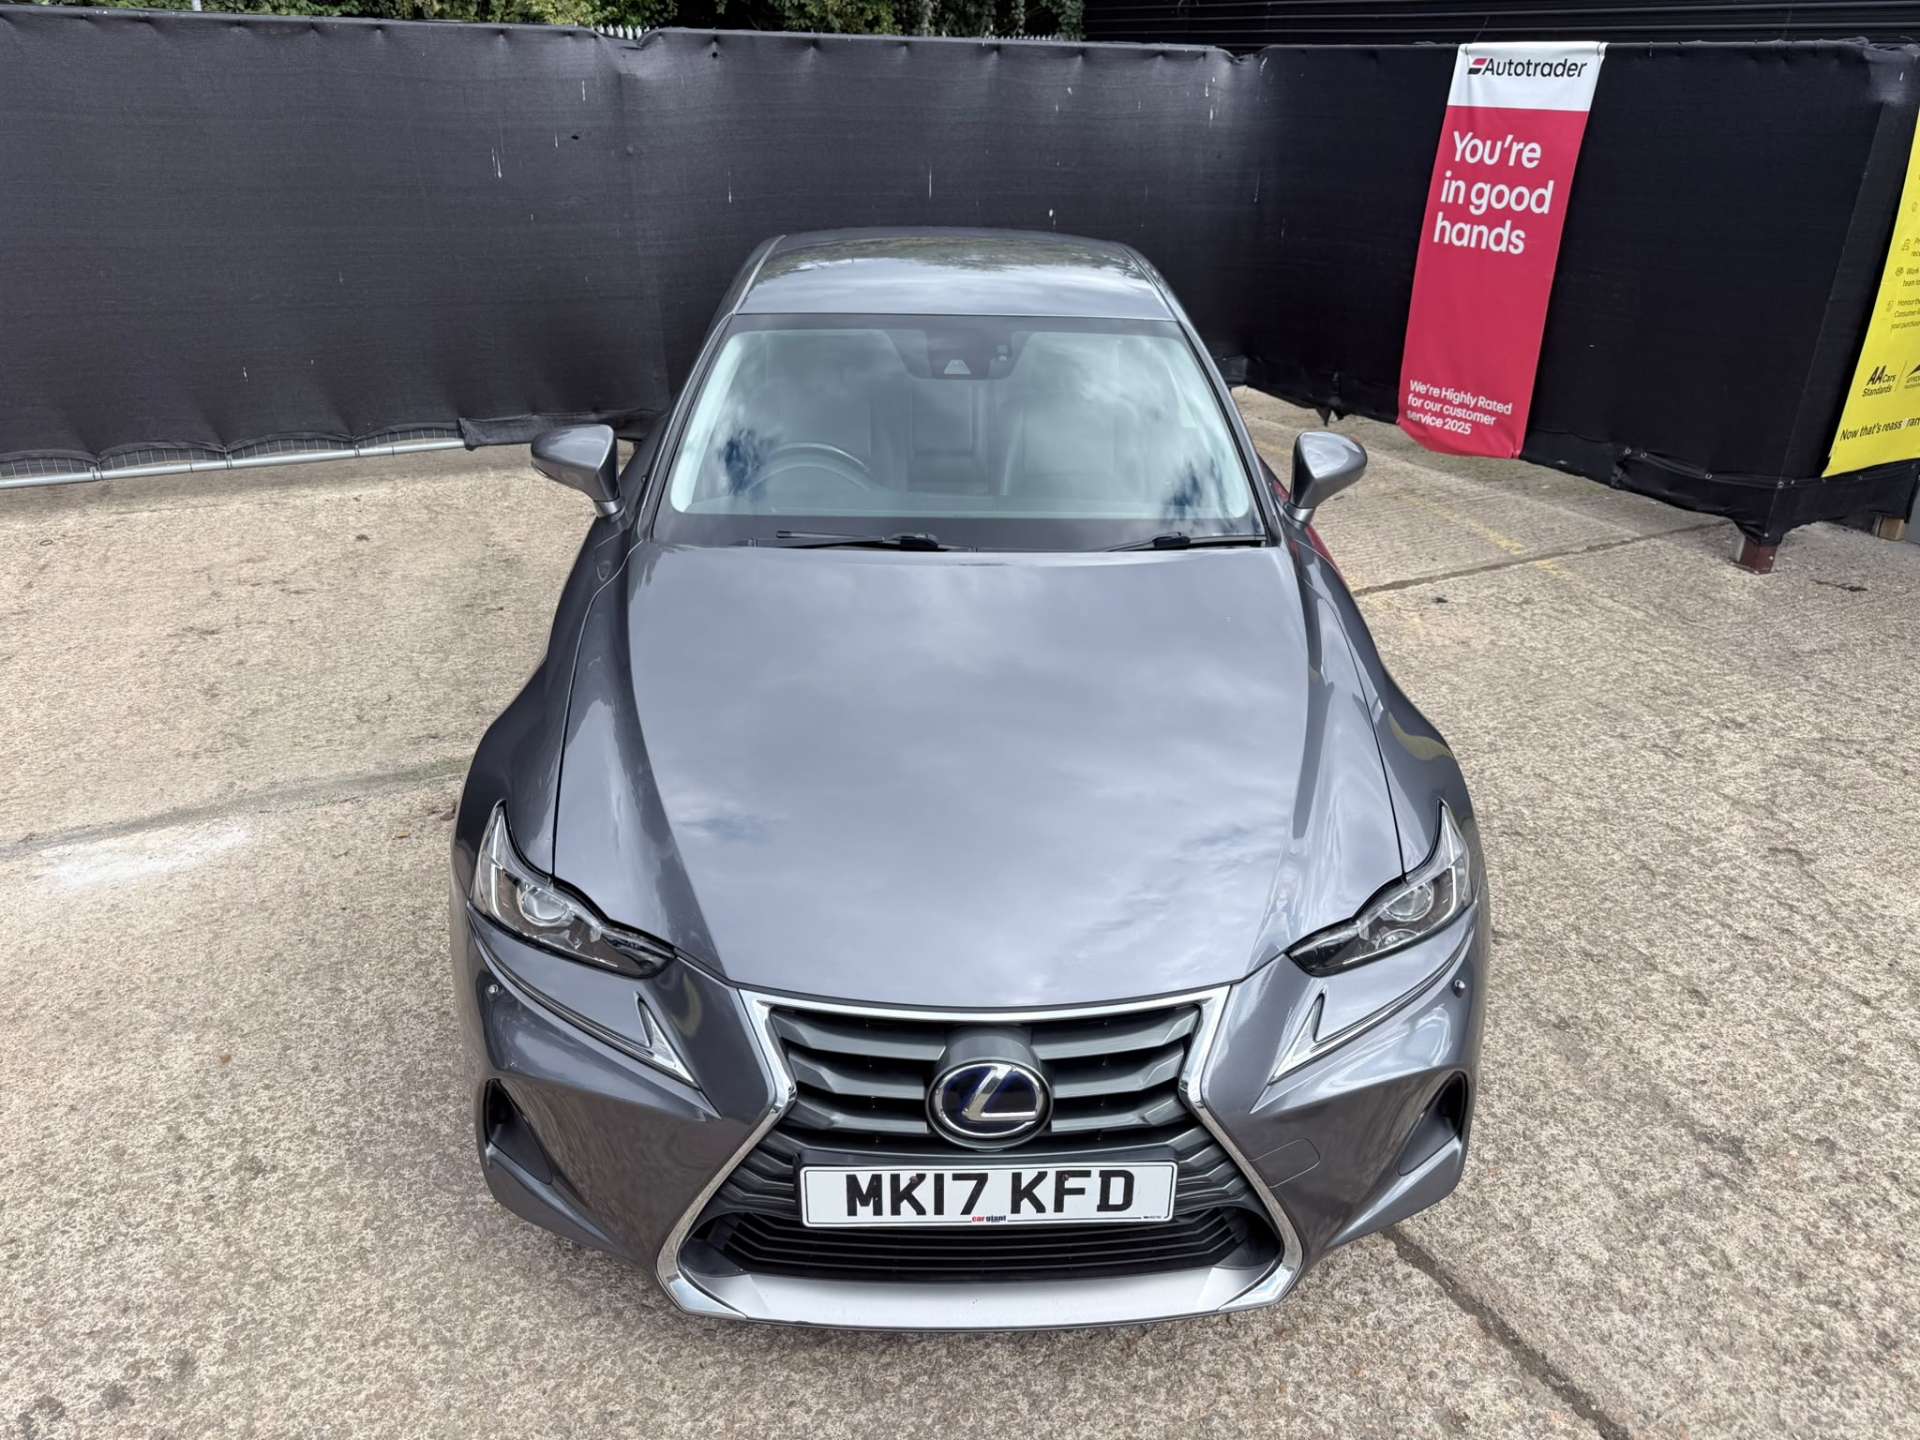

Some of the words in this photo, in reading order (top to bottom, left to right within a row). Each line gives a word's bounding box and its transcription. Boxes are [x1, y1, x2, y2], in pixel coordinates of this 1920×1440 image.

[1482, 58, 1587, 77] Autotrader
[1453, 131, 1541, 168] You're
[1440, 170, 1465, 204] in
[1469, 180, 1554, 215] good
[1433, 212, 1526, 254] hands
[1862, 385, 1892, 398] Standards
[1866, 365, 1887, 386] AA
[1882, 374, 1897, 383] Cars
[1407, 393, 1424, 406] for
[1424, 400, 1442, 413] our
[1442, 404, 1497, 426] customer
[1409, 380, 1441, 397] We're
[1440, 387, 1477, 408] Highly
[1478, 396, 1513, 415] Rated
[1406, 410, 1443, 427] service
[1443, 419, 1472, 435] 2025
[1840, 430, 1858, 442] Now
[1859, 422, 1881, 437] that's
[845, 1172, 989, 1217] MK17
[1010, 1169, 1135, 1214] KFD
